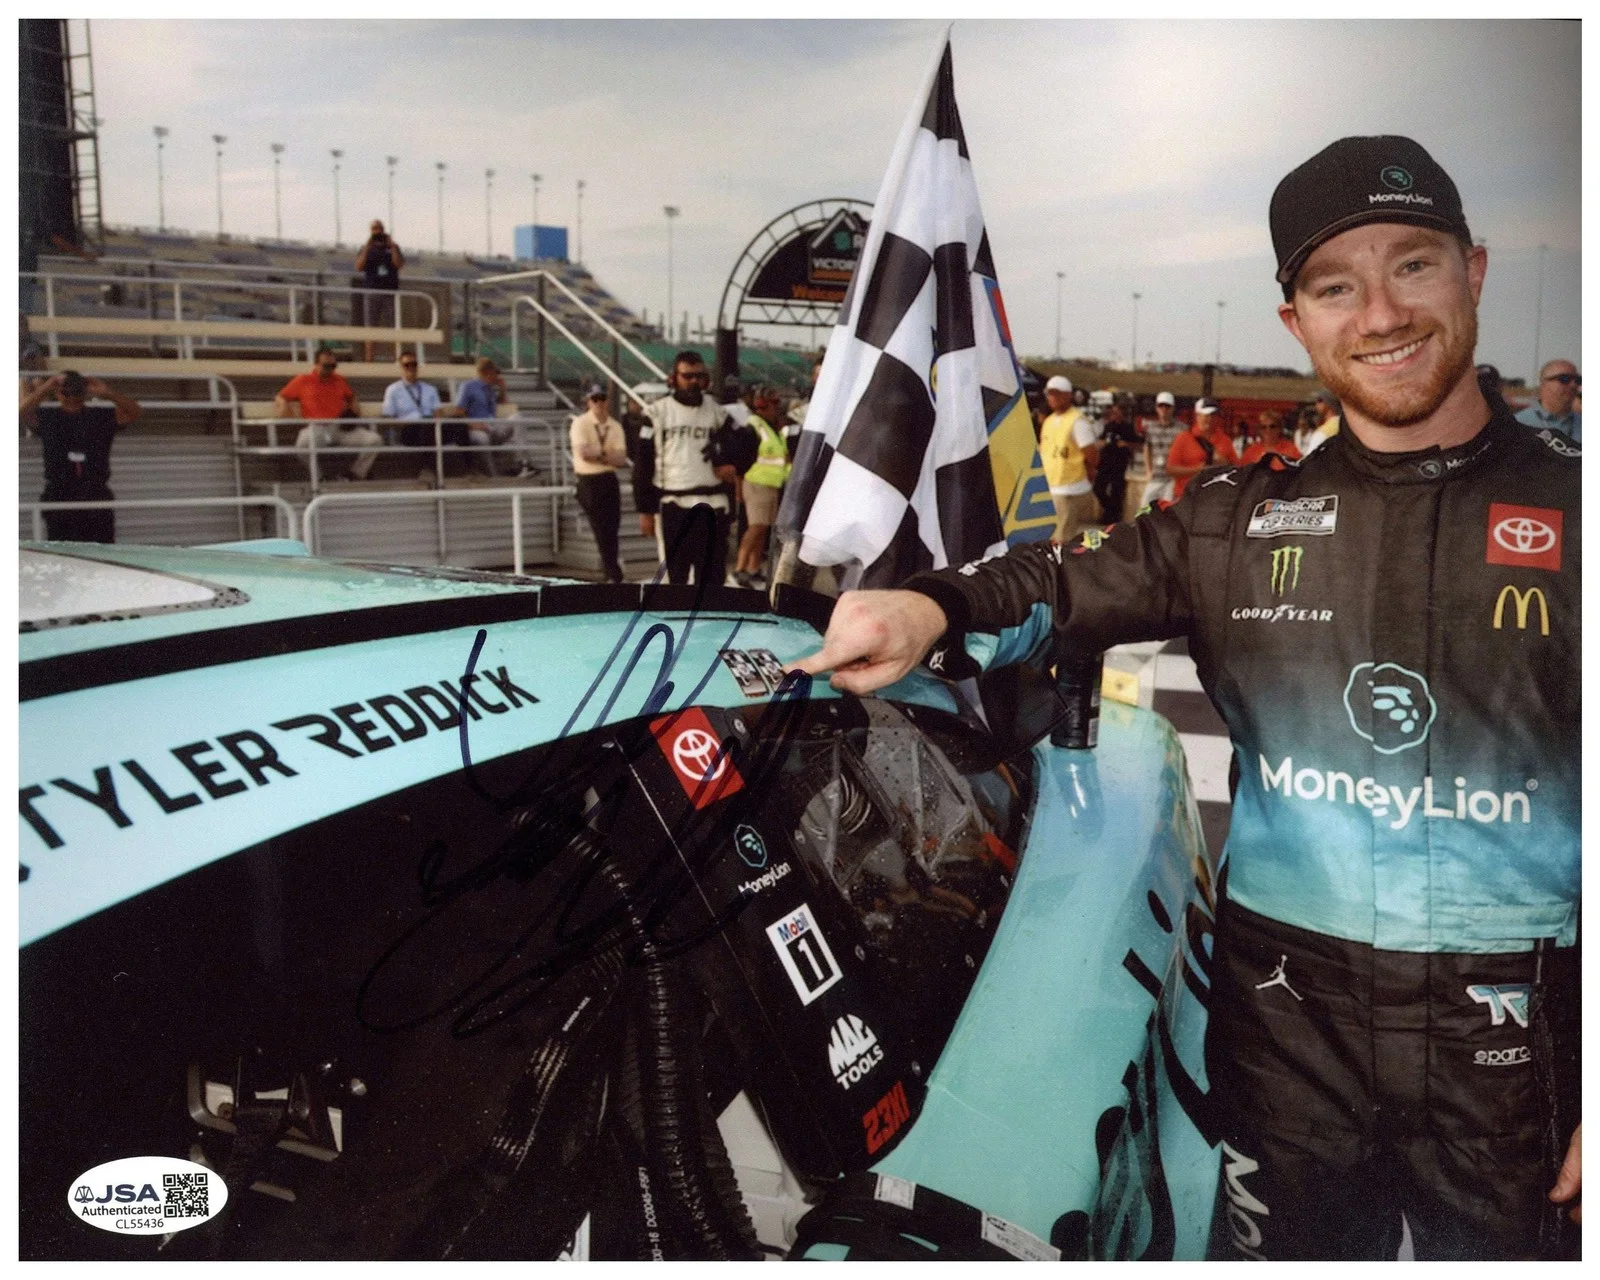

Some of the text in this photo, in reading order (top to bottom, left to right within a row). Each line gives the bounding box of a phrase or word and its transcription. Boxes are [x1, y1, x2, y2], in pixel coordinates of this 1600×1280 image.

[1368, 193, 1434, 206] MoneyLion
[812, 258, 856, 271] VICTOR
[1281, 514, 1324, 527] SERIES
[19, 666, 541, 850] TYLER REDDICK
[1259, 753, 1531, 829] MoneyLion
[777, 912, 809, 943] Mobil
[797, 937, 825, 982] 1
[828, 1014, 878, 1077] MAC
[836, 1045, 884, 1091] TOOLS
